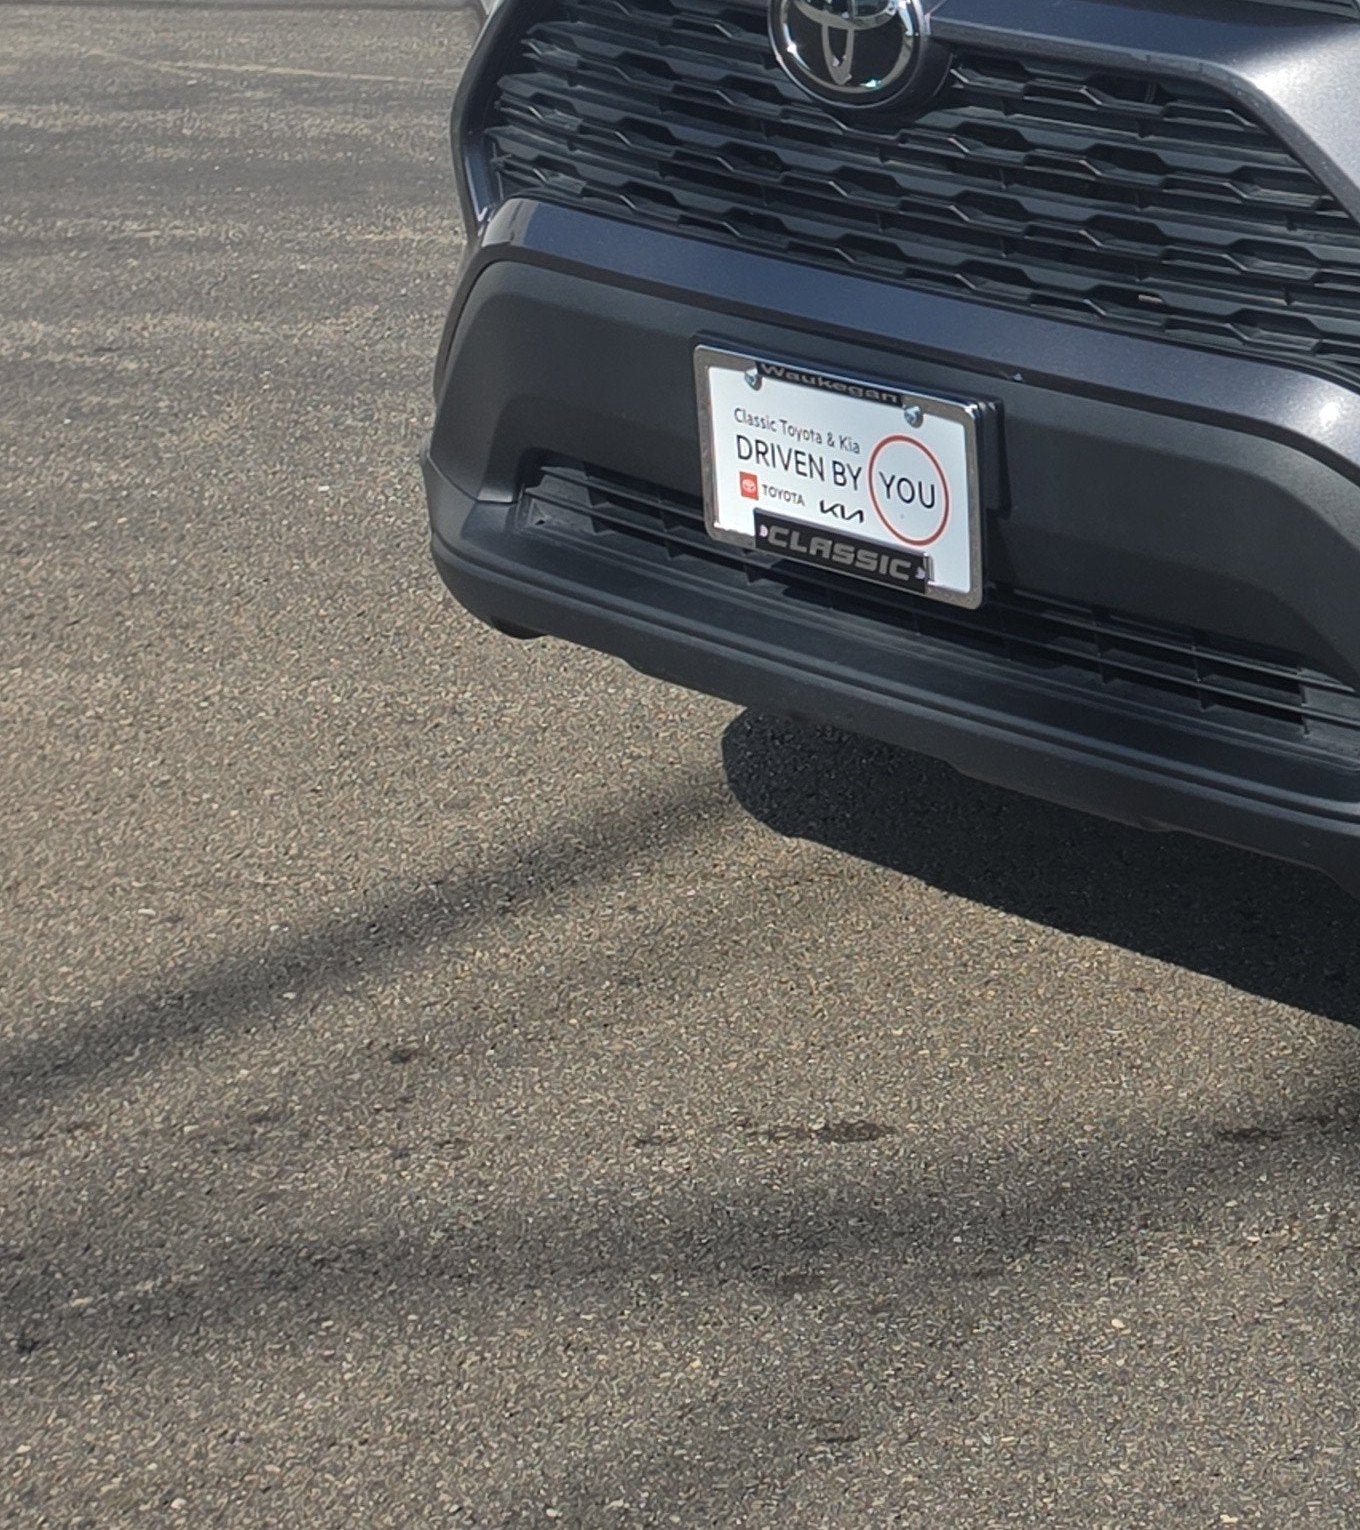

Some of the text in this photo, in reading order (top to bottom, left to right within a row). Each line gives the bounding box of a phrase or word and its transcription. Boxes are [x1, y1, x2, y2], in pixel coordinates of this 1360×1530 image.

[760, 362, 898, 404] Waukegan
[734, 407, 860, 455] Classic Toyota & Kia
[736, 434, 935, 509] DRIVEN BY YOU
[762, 483, 806, 507] TOYOTA
[767, 525, 912, 582] CLASSIC
